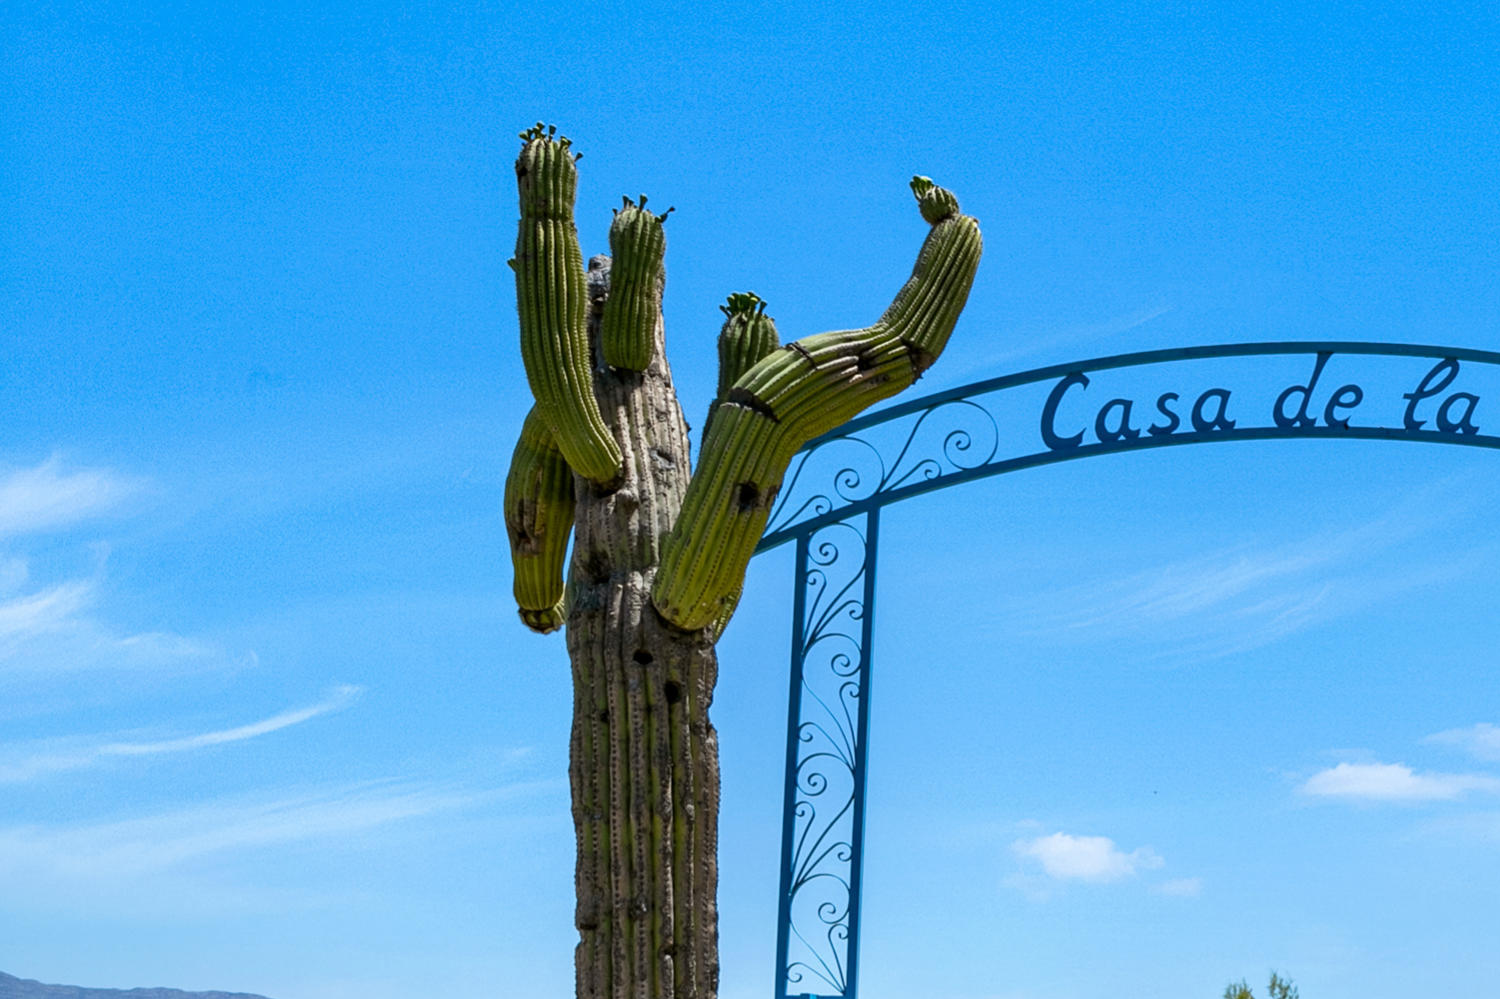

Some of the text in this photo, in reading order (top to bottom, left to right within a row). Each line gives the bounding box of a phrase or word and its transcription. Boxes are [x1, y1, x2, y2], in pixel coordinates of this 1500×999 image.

[1040, 371, 1236, 451] Casa
[1272, 351, 1364, 428] de
[1402, 357, 1480, 435] la
